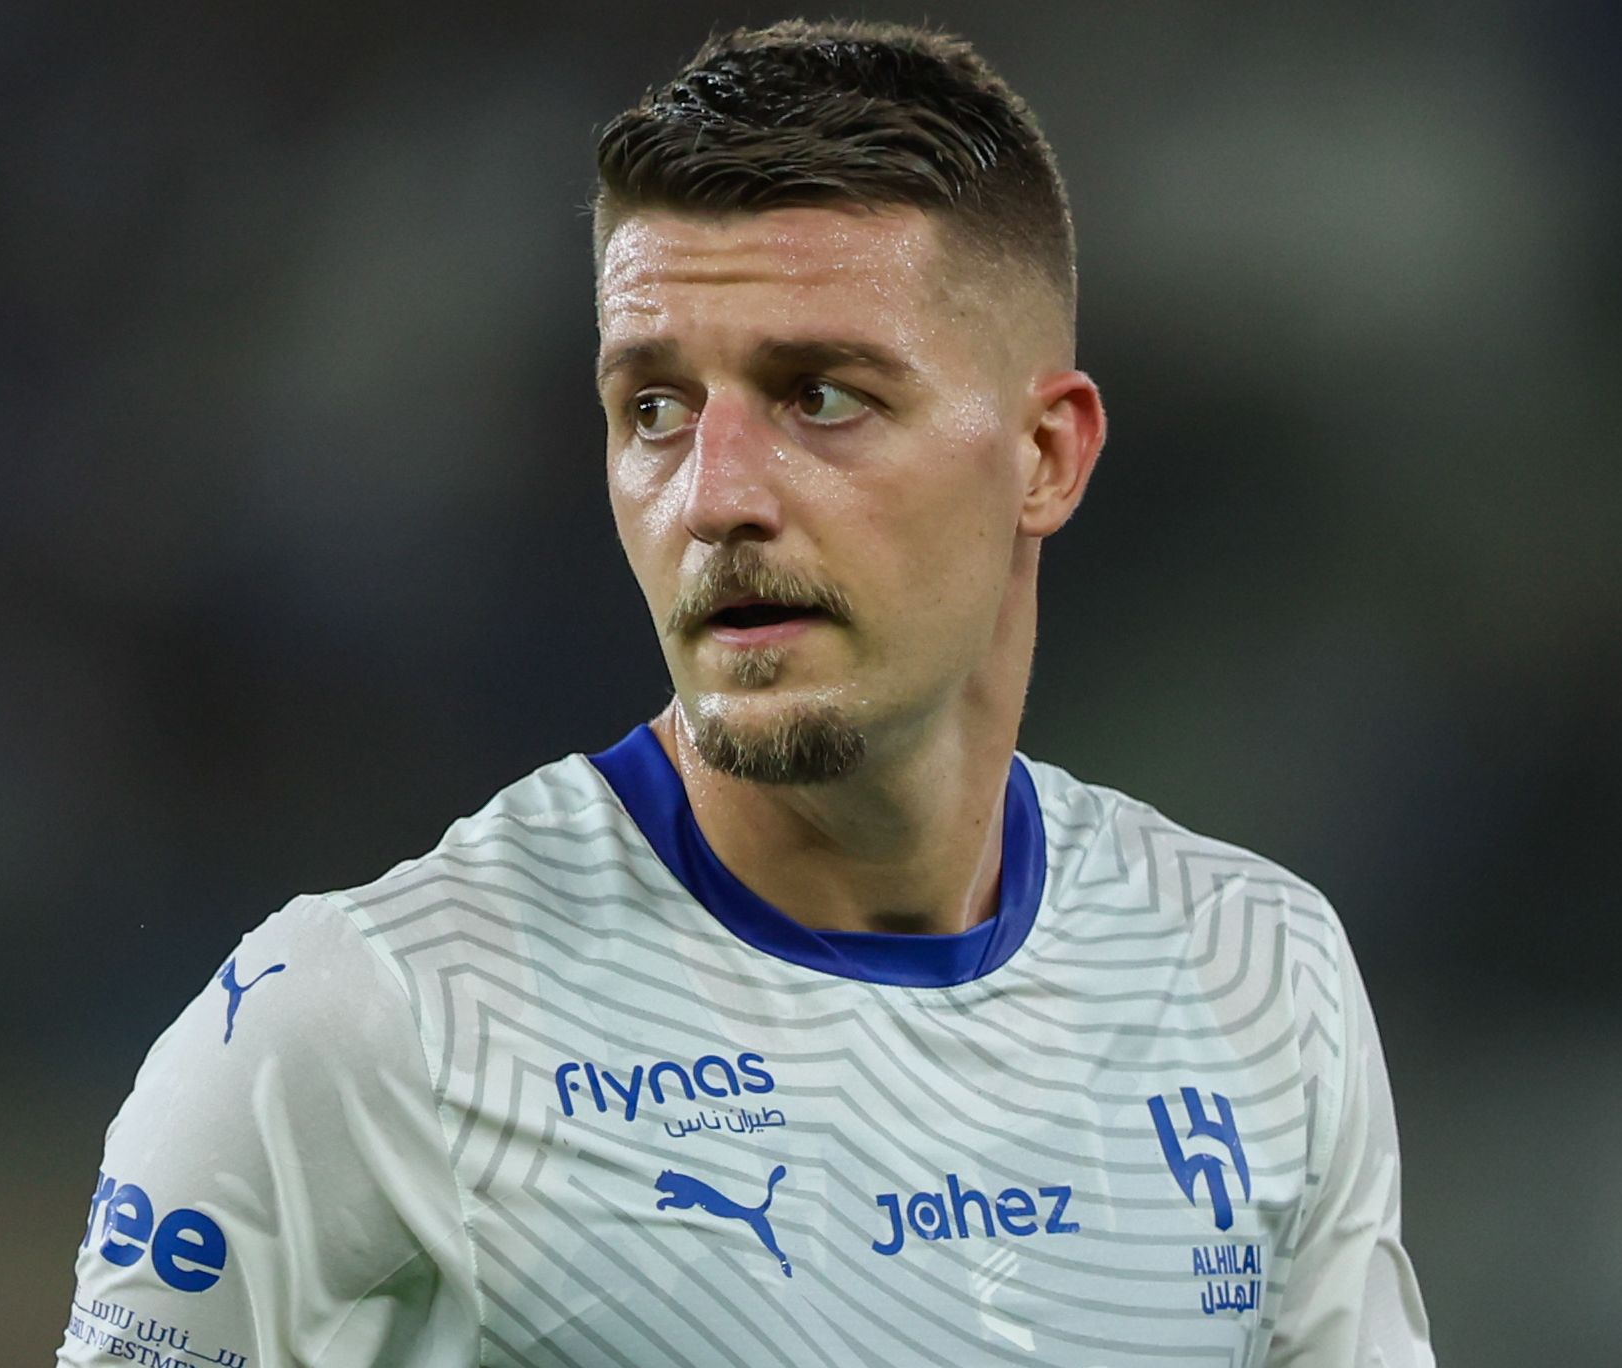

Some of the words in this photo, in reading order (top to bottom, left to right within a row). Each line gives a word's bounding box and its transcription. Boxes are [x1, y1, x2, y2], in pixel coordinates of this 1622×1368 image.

[555, 1052, 775, 1122] flynas
[665, 1110, 721, 1138] ناس
[725, 1107, 786, 1135] طيران
[1201, 1280, 1260, 1314] الهلال
